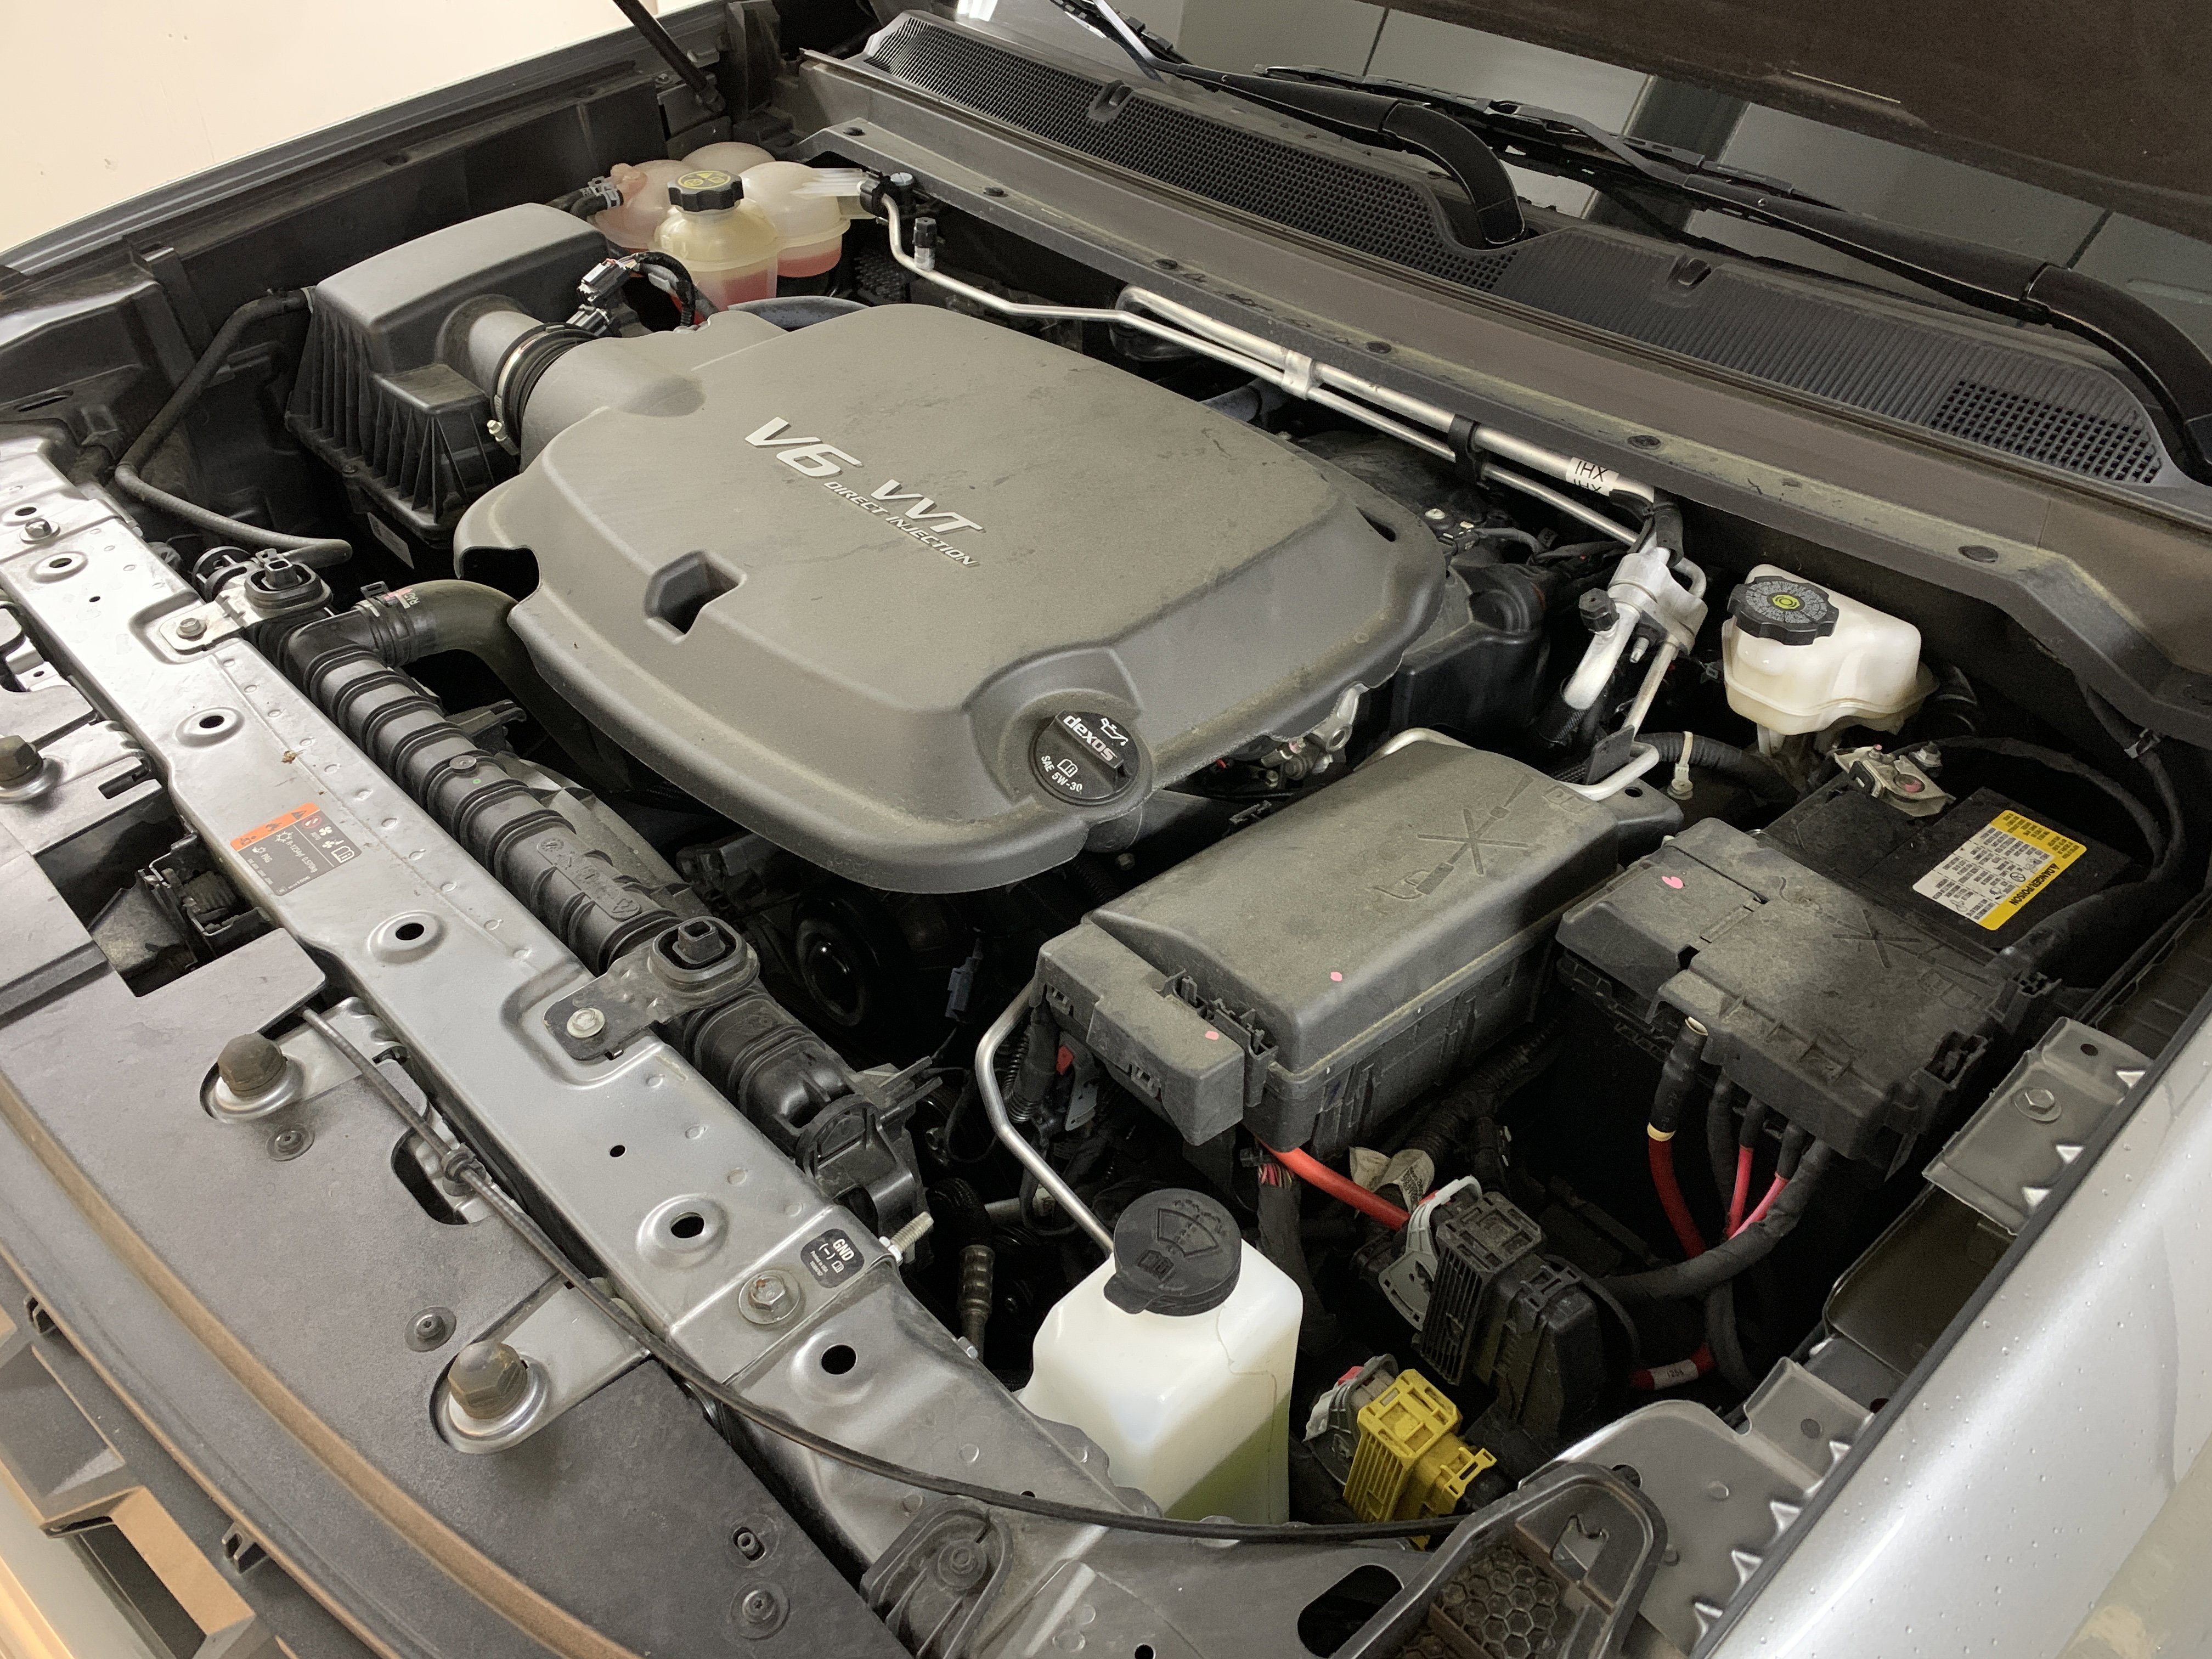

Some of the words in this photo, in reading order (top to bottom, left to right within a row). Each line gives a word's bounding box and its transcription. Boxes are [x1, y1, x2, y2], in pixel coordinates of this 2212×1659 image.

[745, 416, 864, 477] V6
[871, 479, 985, 534] VVT
[1575, 460, 1609, 482] IHX
[824, 481, 889, 515] DIRECT
[885, 516, 980, 567] INJECTION
[1063, 715, 1118, 761] dexos
[1041, 755, 1055, 772] SAE
[1052, 772, 1083, 793] 5W-30
[260, 853, 273, 863] PAG
[833, 1238, 855, 1261] GND
